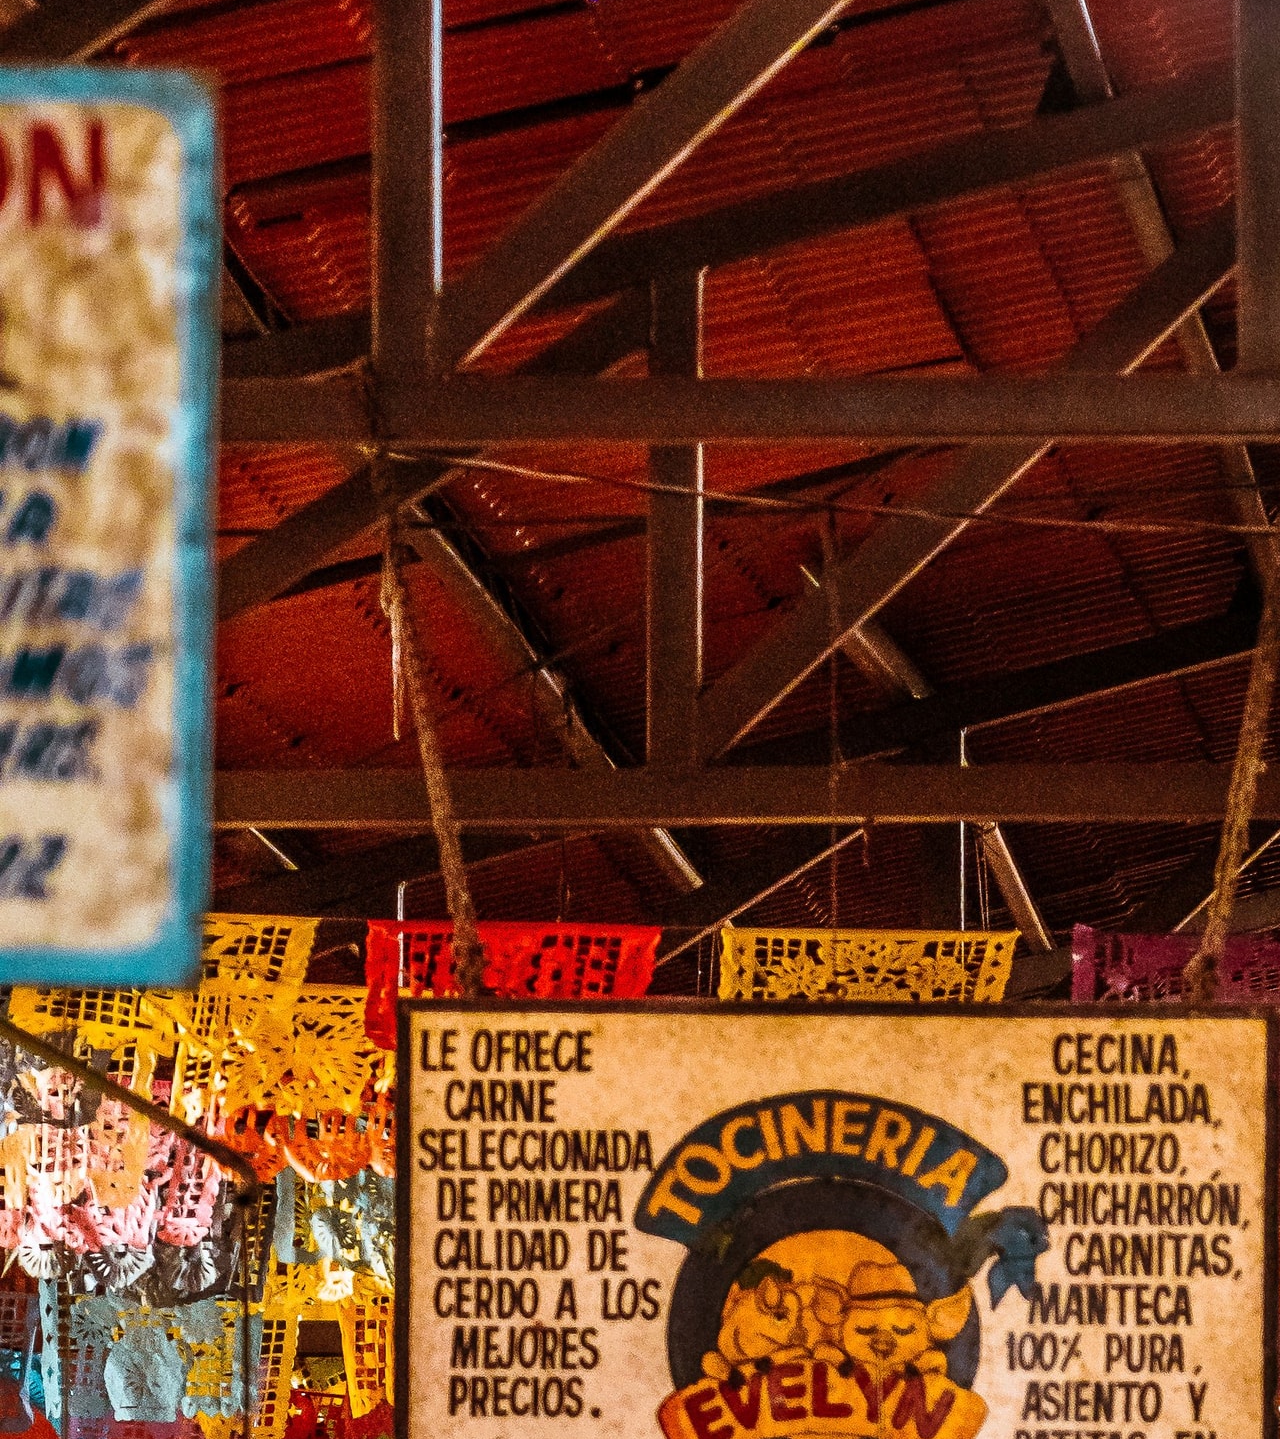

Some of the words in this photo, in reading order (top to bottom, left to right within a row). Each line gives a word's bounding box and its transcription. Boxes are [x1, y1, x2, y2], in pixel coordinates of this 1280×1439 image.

[420, 1029, 458, 1072] LE
[470, 1028, 593, 1073] OFRECE
[1051, 1032, 1190, 1079] CECINA,
[444, 1079, 556, 1123] CARNE
[1021, 1081, 1220, 1127] ENCHILADA,
[417, 1128, 654, 1172] SELECCIONADA
[649, 1096, 981, 1229] TOCINERIA
[436, 1177, 477, 1223] DE
[487, 1178, 623, 1223] PRIMERA
[433, 1228, 570, 1272] CALIDAD
[587, 1229, 628, 1273] DE
[1064, 1232, 1241, 1281] CARNITAS,
[433, 1276, 540, 1320] CERDO
[554, 1278, 578, 1321] A
[601, 1278, 661, 1322] LOS
[1027, 1283, 1193, 1326] MANTECA
[450, 1323, 600, 1371] MEJORES
[1006, 1331, 1081, 1372] 100%
[448, 1374, 602, 1419] PRECIOS.
[1021, 1380, 1163, 1423] ASIENTO
[1188, 1382, 1208, 1423] Y
